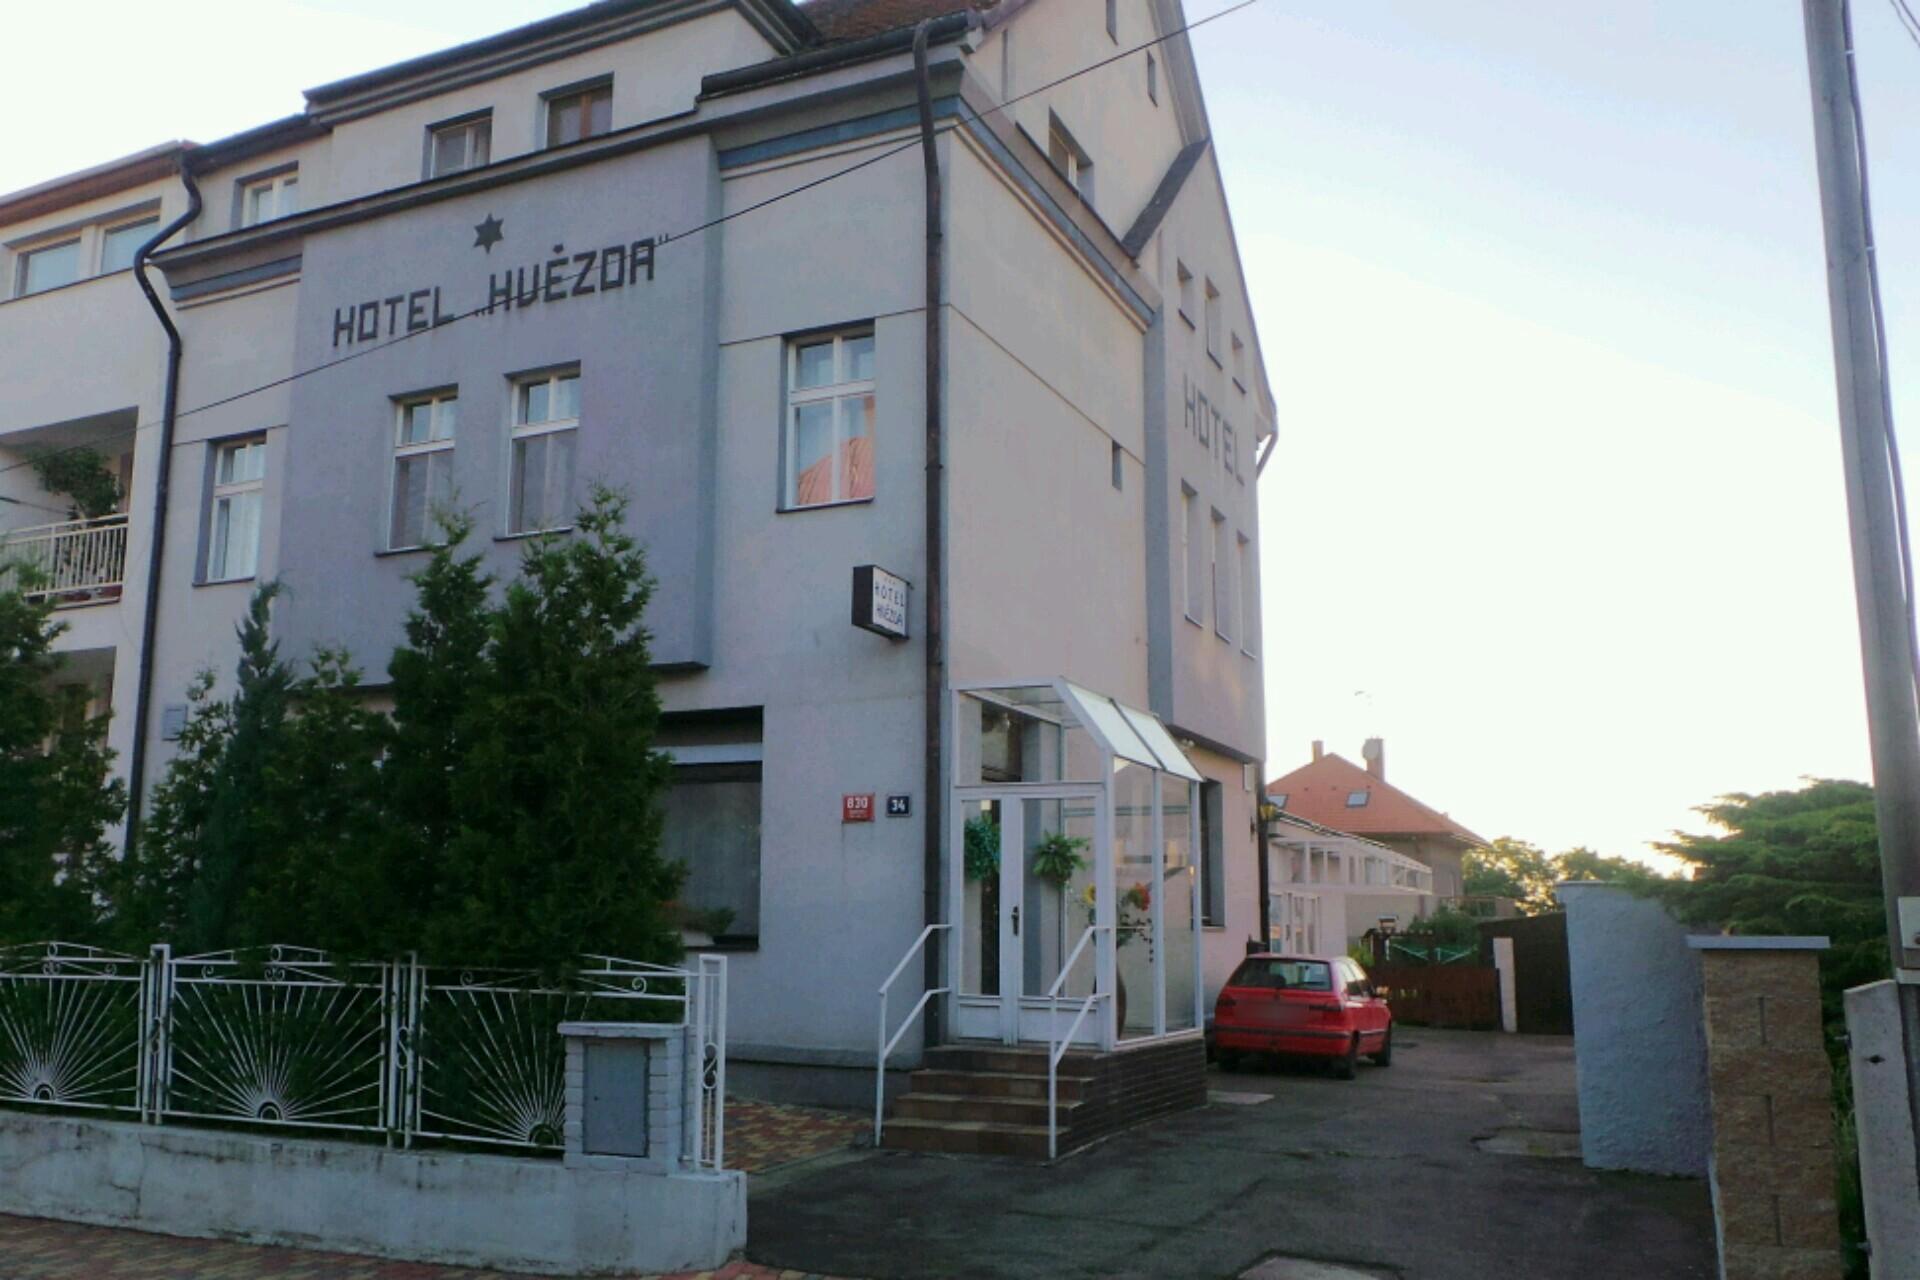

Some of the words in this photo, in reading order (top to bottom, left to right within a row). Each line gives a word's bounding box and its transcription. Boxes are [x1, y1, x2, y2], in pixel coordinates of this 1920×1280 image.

[333, 286, 455, 347] HOTEL
[1183, 373, 1245, 487] HOTEL
[874, 581, 905, 608] HOTEL
[892, 799, 905, 811] 34
